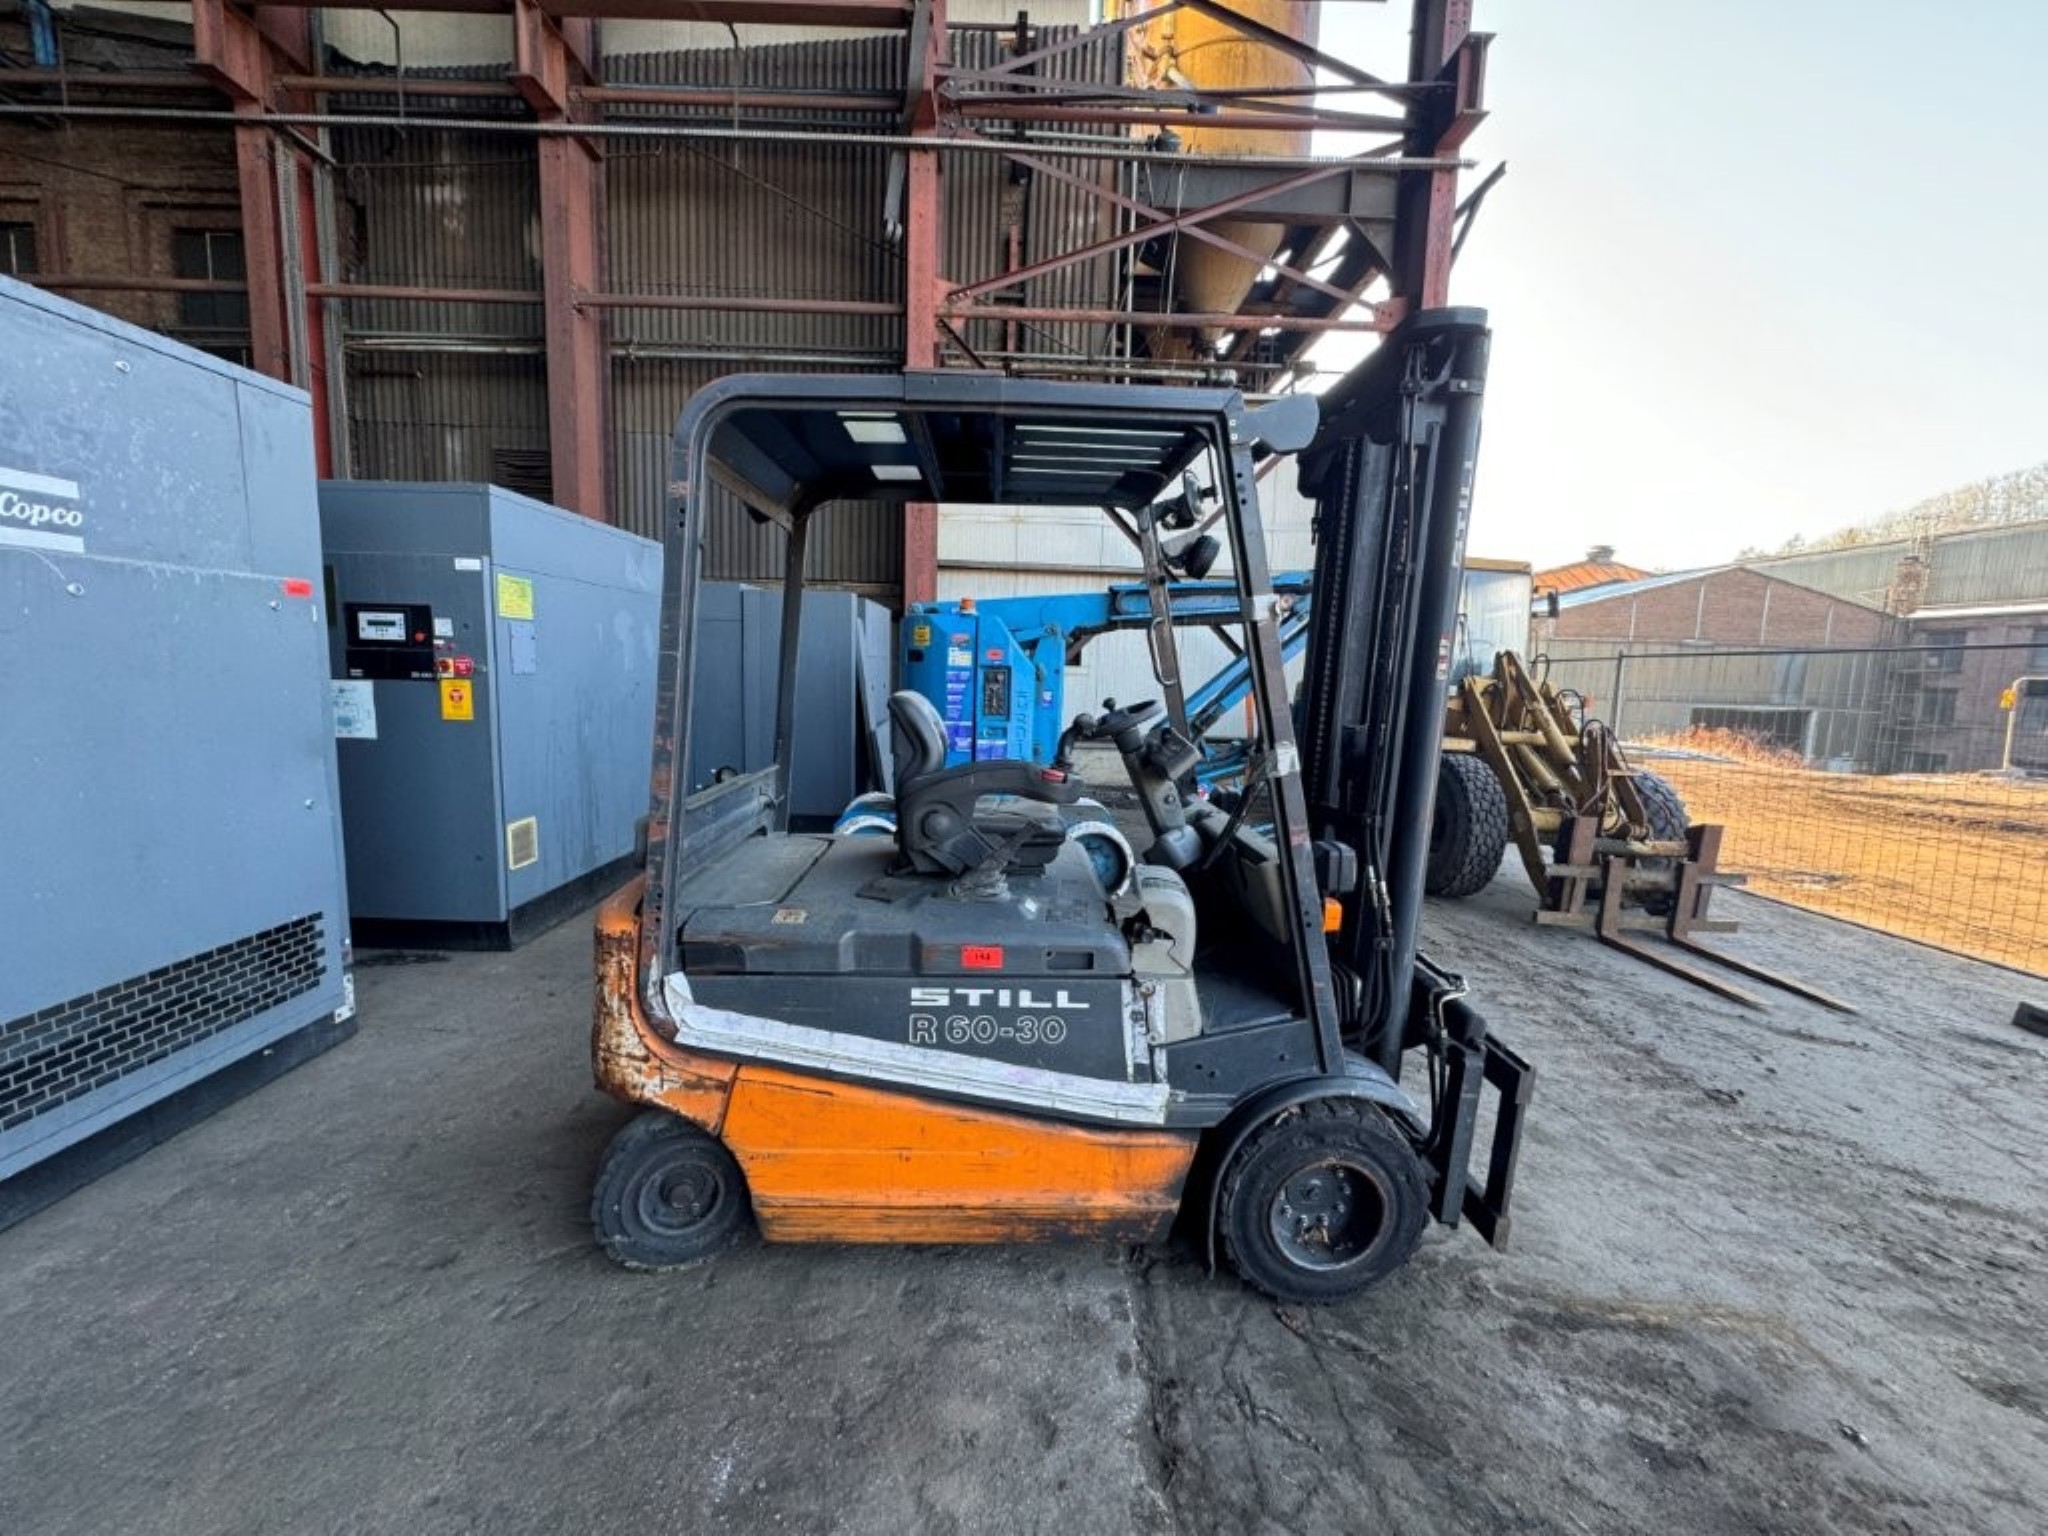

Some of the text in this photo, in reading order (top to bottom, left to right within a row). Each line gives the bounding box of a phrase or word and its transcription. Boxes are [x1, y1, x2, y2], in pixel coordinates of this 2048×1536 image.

[0, 491, 82, 527] Copco
[911, 987, 1091, 1009] STILL
[908, 1012, 1067, 1045] R 60-30
